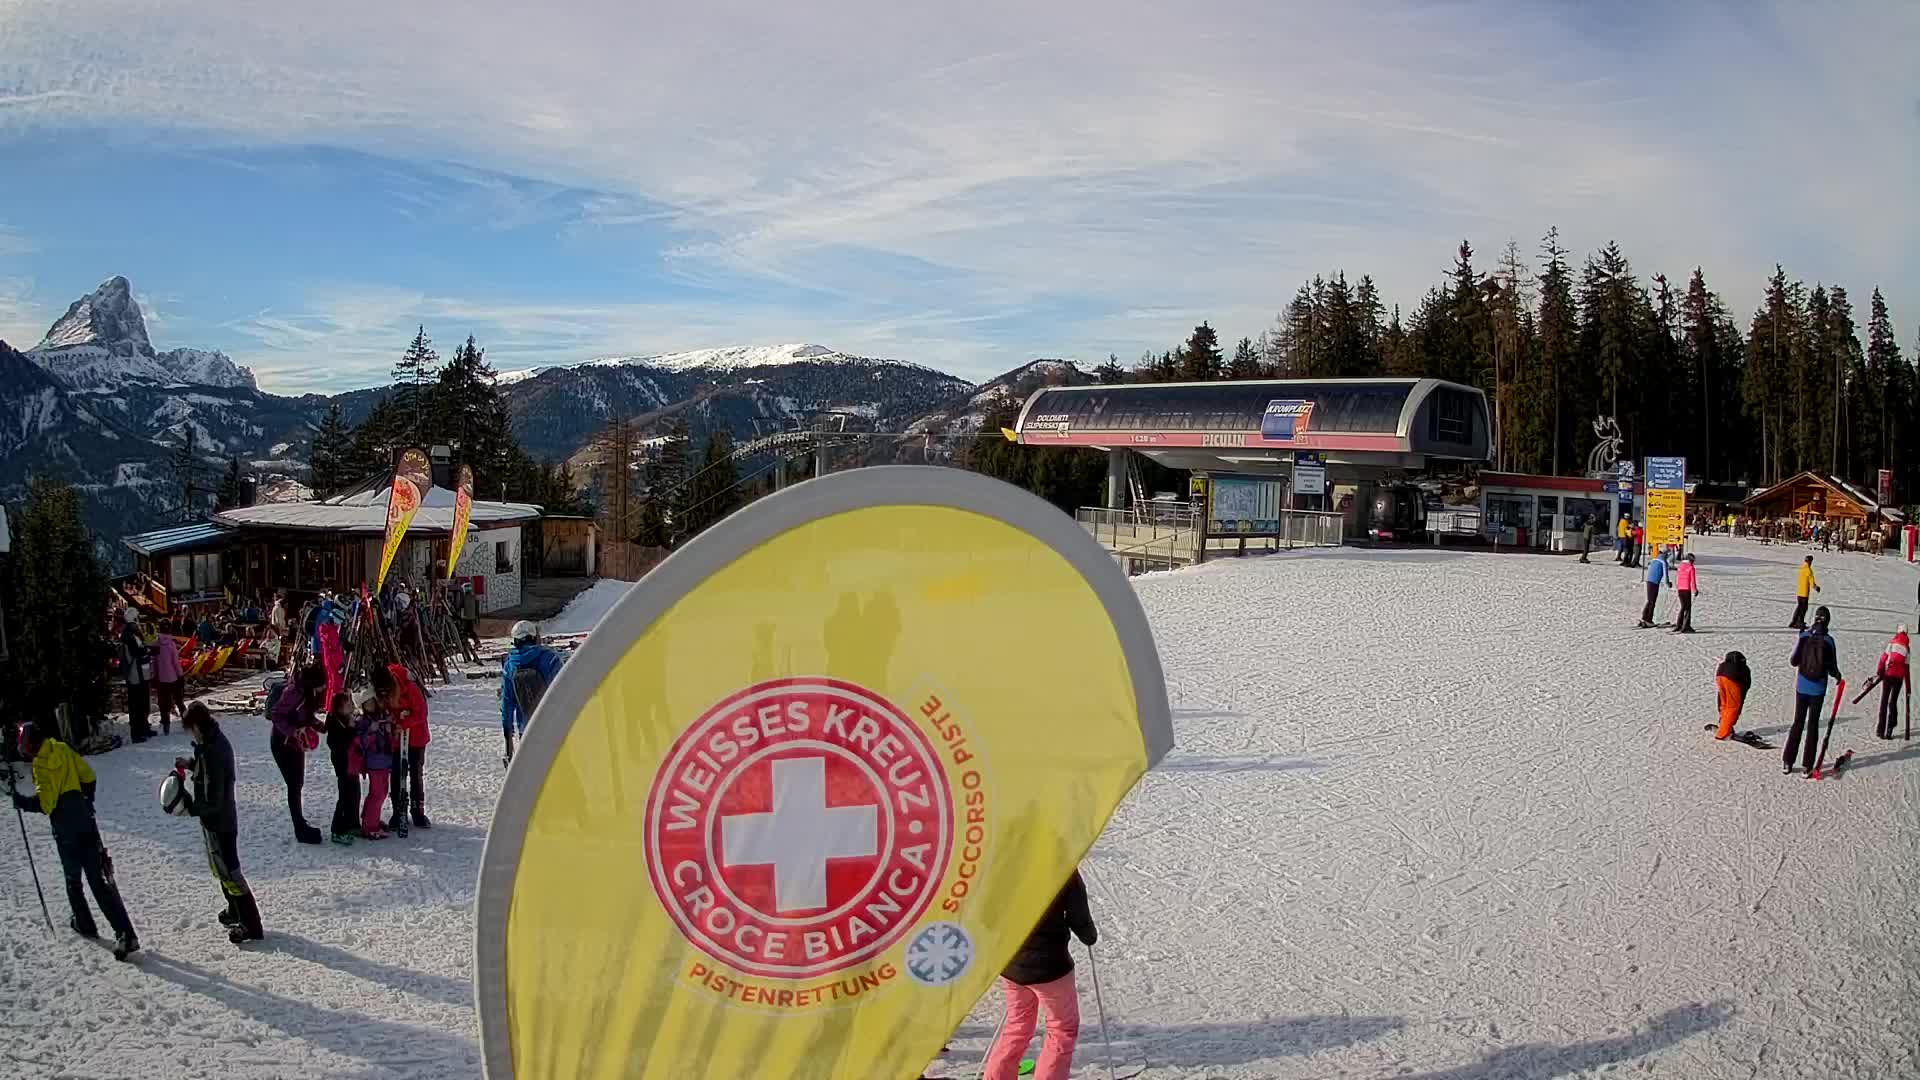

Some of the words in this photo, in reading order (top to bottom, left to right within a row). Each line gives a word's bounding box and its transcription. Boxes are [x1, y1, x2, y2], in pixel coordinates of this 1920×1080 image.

[1036, 414, 1069, 422] DOLOMITI
[1267, 405, 1312, 413] KRONPLATZ
[1202, 433, 1245, 447] PICULIN
[919, 695, 974, 766] PISTE
[665, 700, 811, 831] WEISSES
[822, 703, 932, 815] KREUZ
[941, 769, 986, 913] SOCCORSO
[673, 858, 787, 960] CROCE
[802, 842, 932, 960] BIANCA
[687, 962, 897, 1008] PISTENRETTUNG
